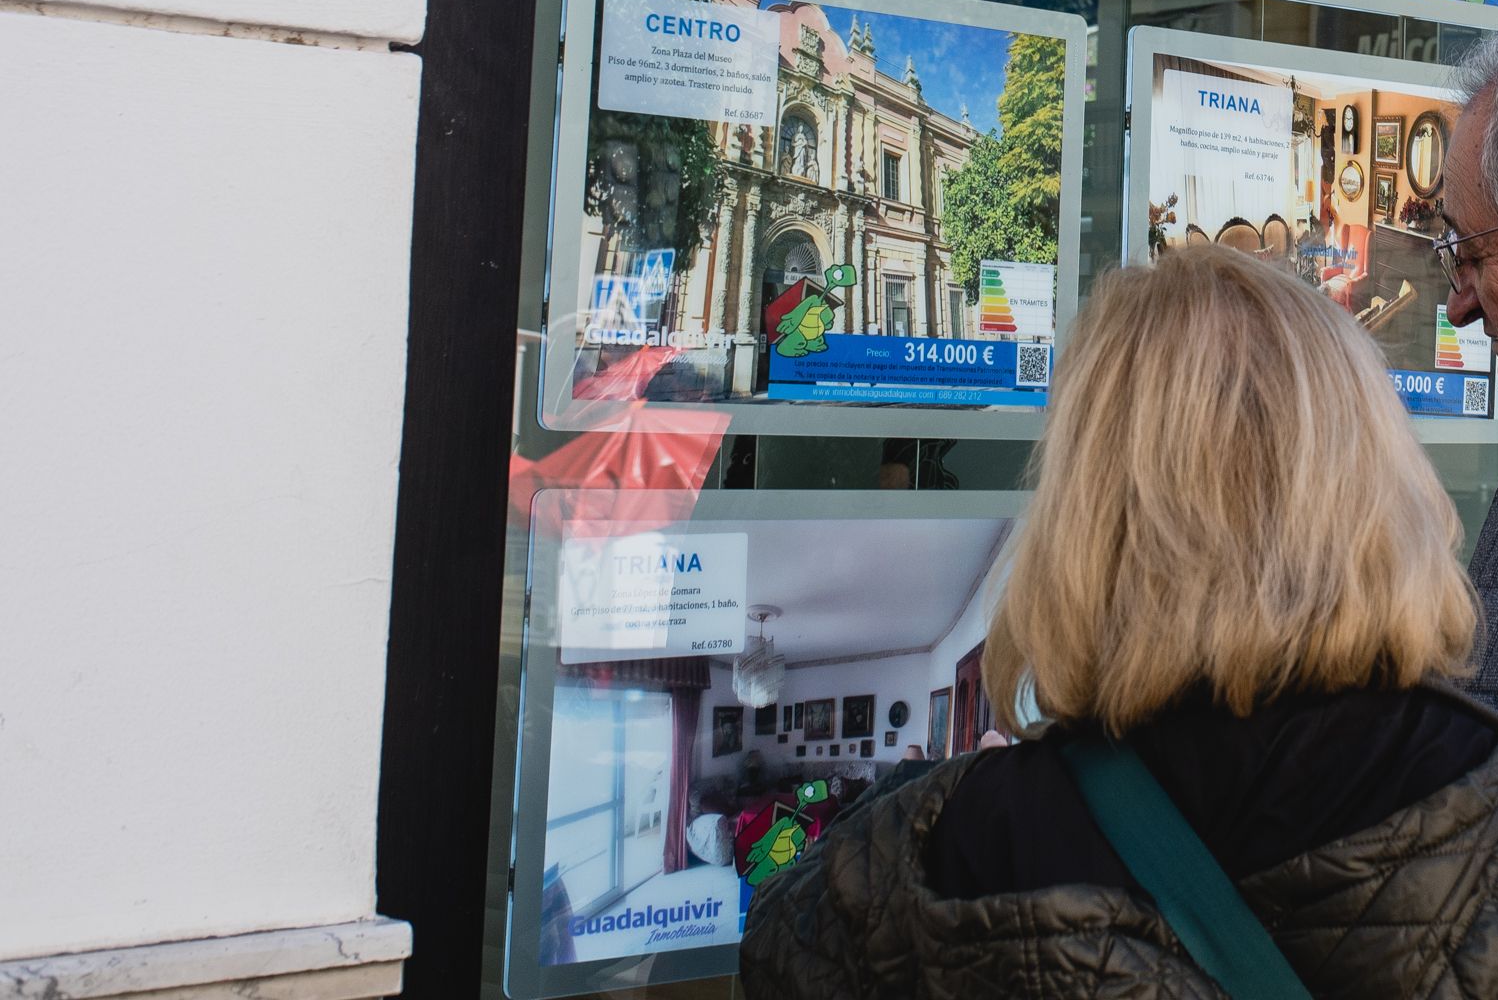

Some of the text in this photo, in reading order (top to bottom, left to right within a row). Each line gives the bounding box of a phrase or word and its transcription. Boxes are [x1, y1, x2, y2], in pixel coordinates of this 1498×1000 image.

[646, 13, 741, 43] CENTRO
[651, 46, 732, 63] Zona Plaza del Museo
[608, 55, 626, 66] Piso
[627, 57, 637, 67] de
[664, 61, 670, 71] 3
[671, 61, 719, 77] dormitorios,
[720, 68, 725, 77] 2
[726, 69, 751, 80] baños,
[752, 72, 771, 83] salón
[624, 73, 754, 95] amplio y azotea. Trastero incluido.
[1198, 90, 1261, 115] TRIANA
[724, 108, 764, 121] Ref. 63687
[1170, 125, 1198, 137] Magnífico
[1199, 130, 1211, 139] piso
[1212, 131, 1219, 139] de
[1249, 137, 1285, 150] habitaciones,
[1180, 139, 1199, 149] baños,
[1200, 143, 1220, 153] cocina,
[1220, 146, 1240, 156] amplio
[1241, 148, 1256, 156] salón
[1261, 151, 1279, 160] garaje
[1245, 172, 1257, 180] Ref.
[904, 341, 977, 365] 314.000
[983, 345, 995, 366] €
[1389, 374, 1445, 395] 5.000 €
[613, 553, 703, 575] TRIANA
[658, 587, 669, 597] de
[671, 586, 701, 596] Gomara
[571, 607, 590, 616] Gran
[592, 607, 609, 617] piso
[610, 606, 621, 614] de
[659, 601, 711, 613] habitaciones,
[711, 599, 716, 609] 1
[717, 599, 739, 609] baño,
[691, 639, 733, 650] Ref. 63780
[567, 897, 723, 937] Guadalquivir
[645, 922, 718, 946] Inmobiliaria
